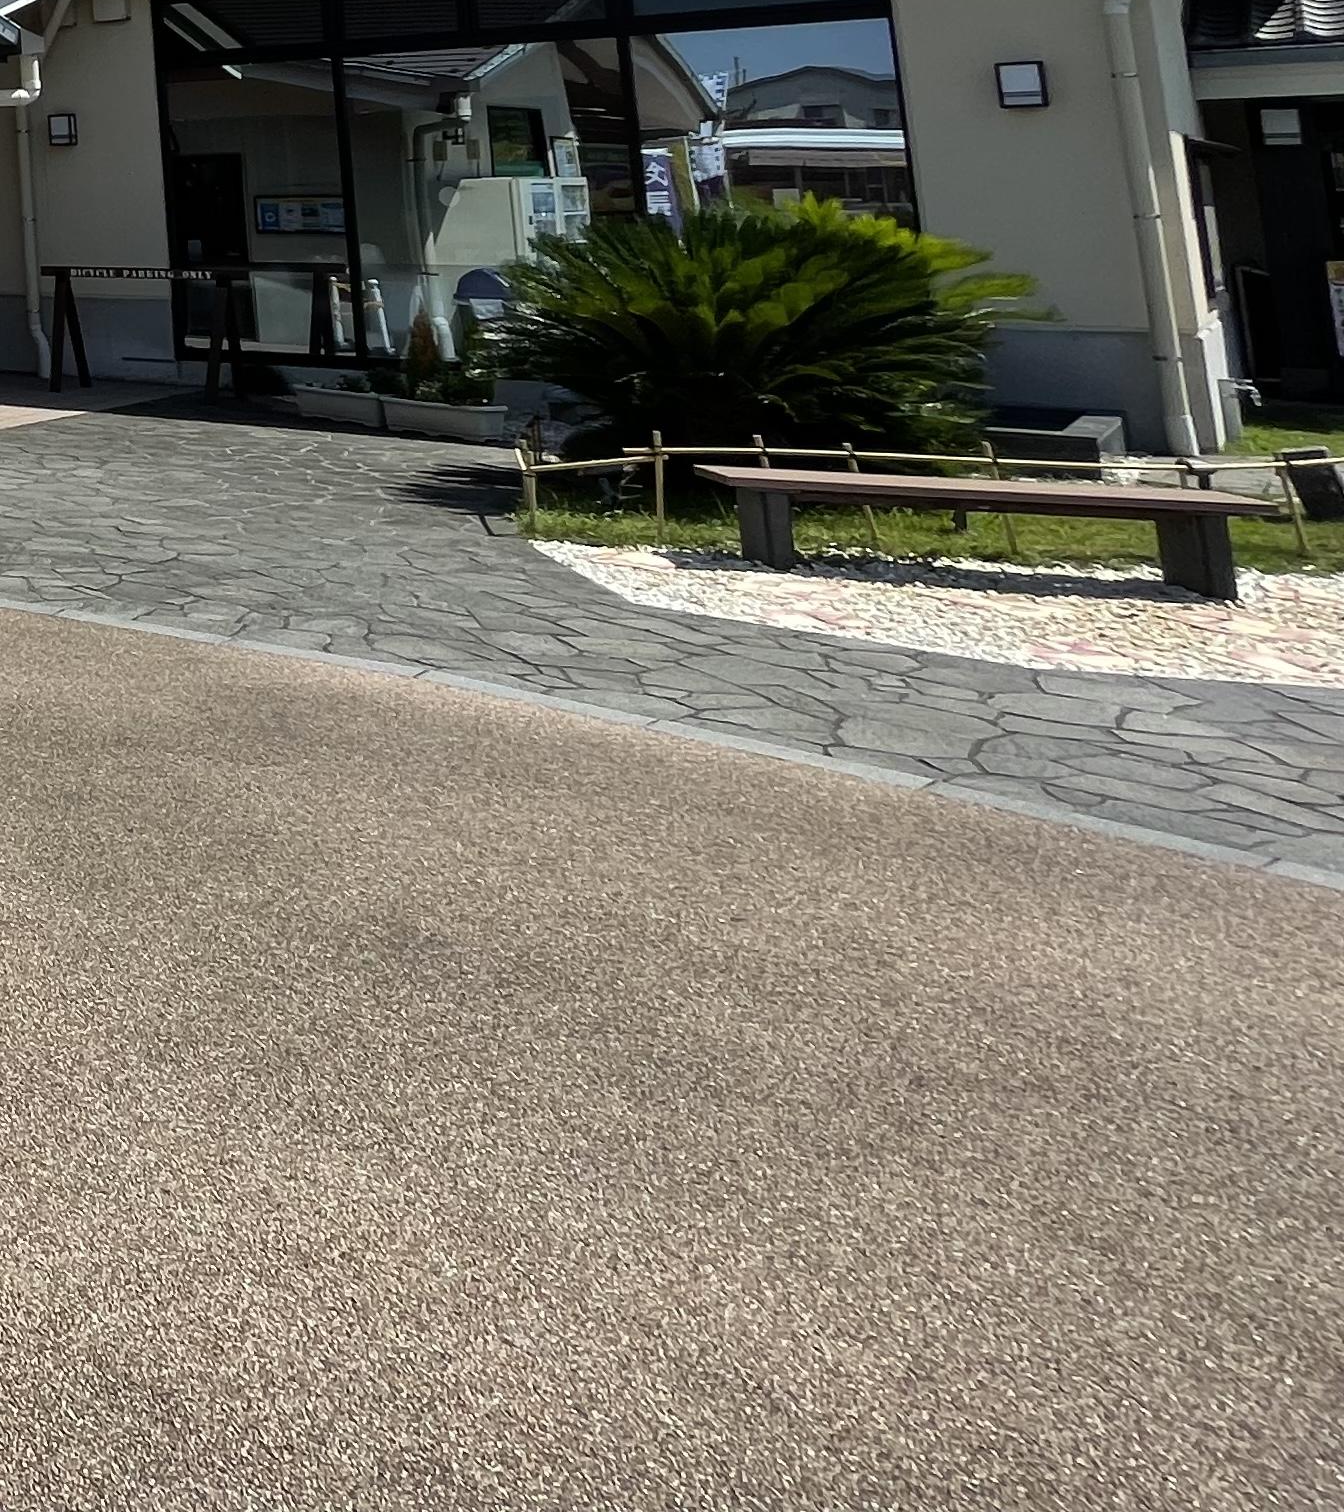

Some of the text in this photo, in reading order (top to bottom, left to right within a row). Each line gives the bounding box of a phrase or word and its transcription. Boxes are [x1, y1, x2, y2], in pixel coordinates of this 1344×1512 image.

[70, 268, 212, 279] BICYCLE PARKING ONLY
